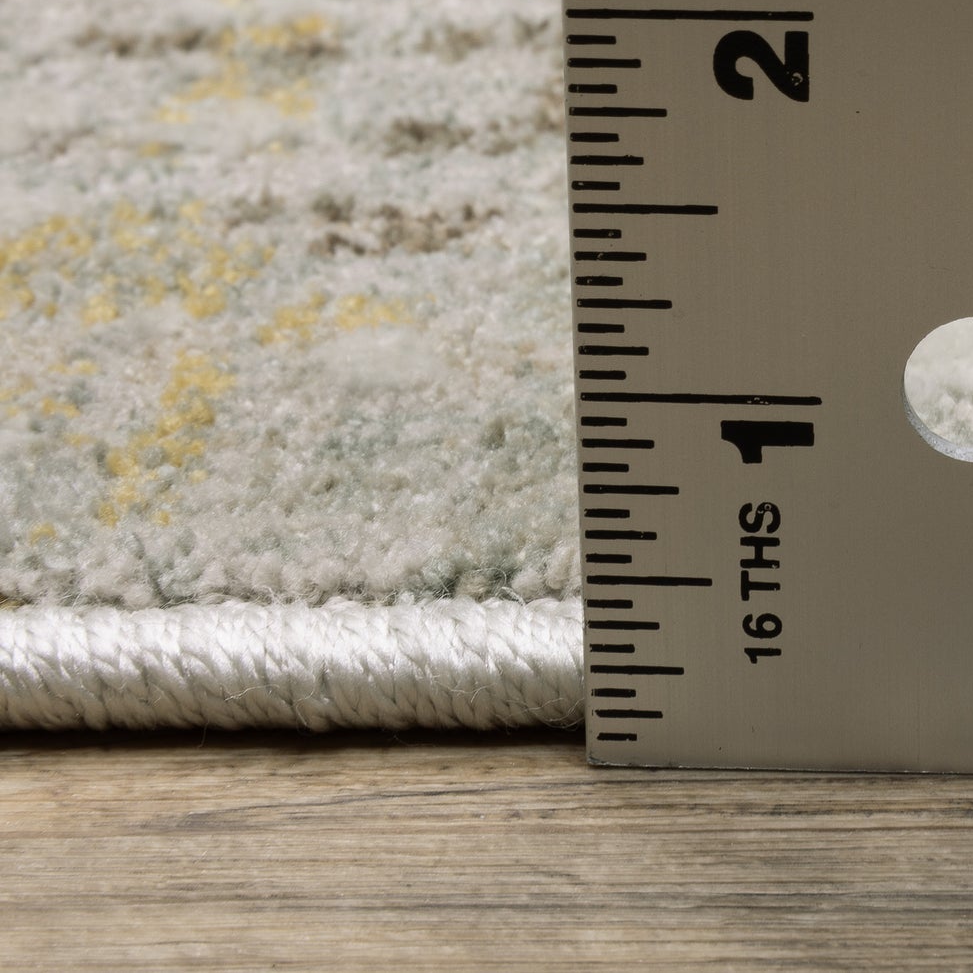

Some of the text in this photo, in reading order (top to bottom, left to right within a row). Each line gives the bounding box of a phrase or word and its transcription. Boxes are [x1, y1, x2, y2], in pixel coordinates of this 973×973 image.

[713, 30, 809, 102] 2
[721, 420, 814, 464] 1
[739, 502, 782, 664] 16 THS
